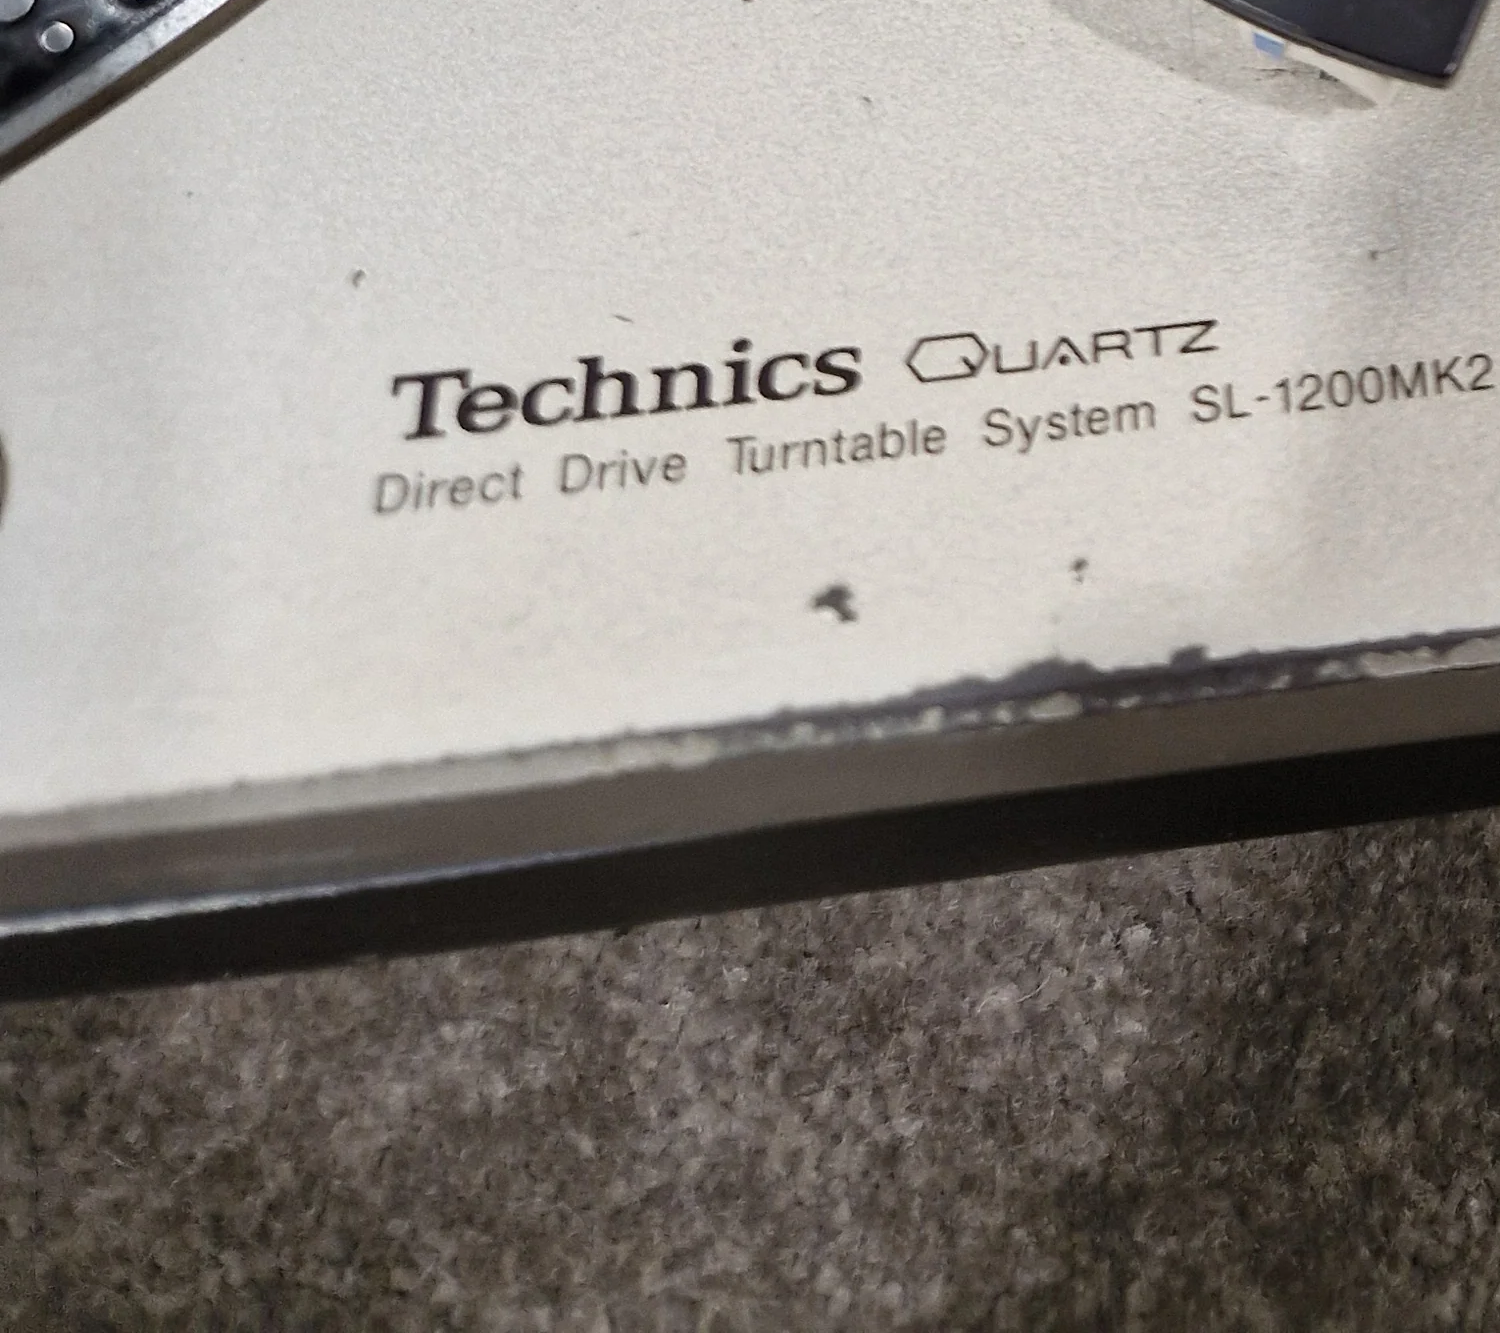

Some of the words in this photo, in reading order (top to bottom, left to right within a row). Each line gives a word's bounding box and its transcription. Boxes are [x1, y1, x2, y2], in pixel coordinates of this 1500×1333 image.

[374, 463, 525, 515] Direct
[558, 448, 688, 497] Drive
[725, 416, 948, 477] Turntable
[982, 398, 1157, 455] System
[1189, 352, 1496, 425] SL-1200MK2
[391, 336, 863, 442] Technics
[905, 318, 1221, 384] QUARTZ
